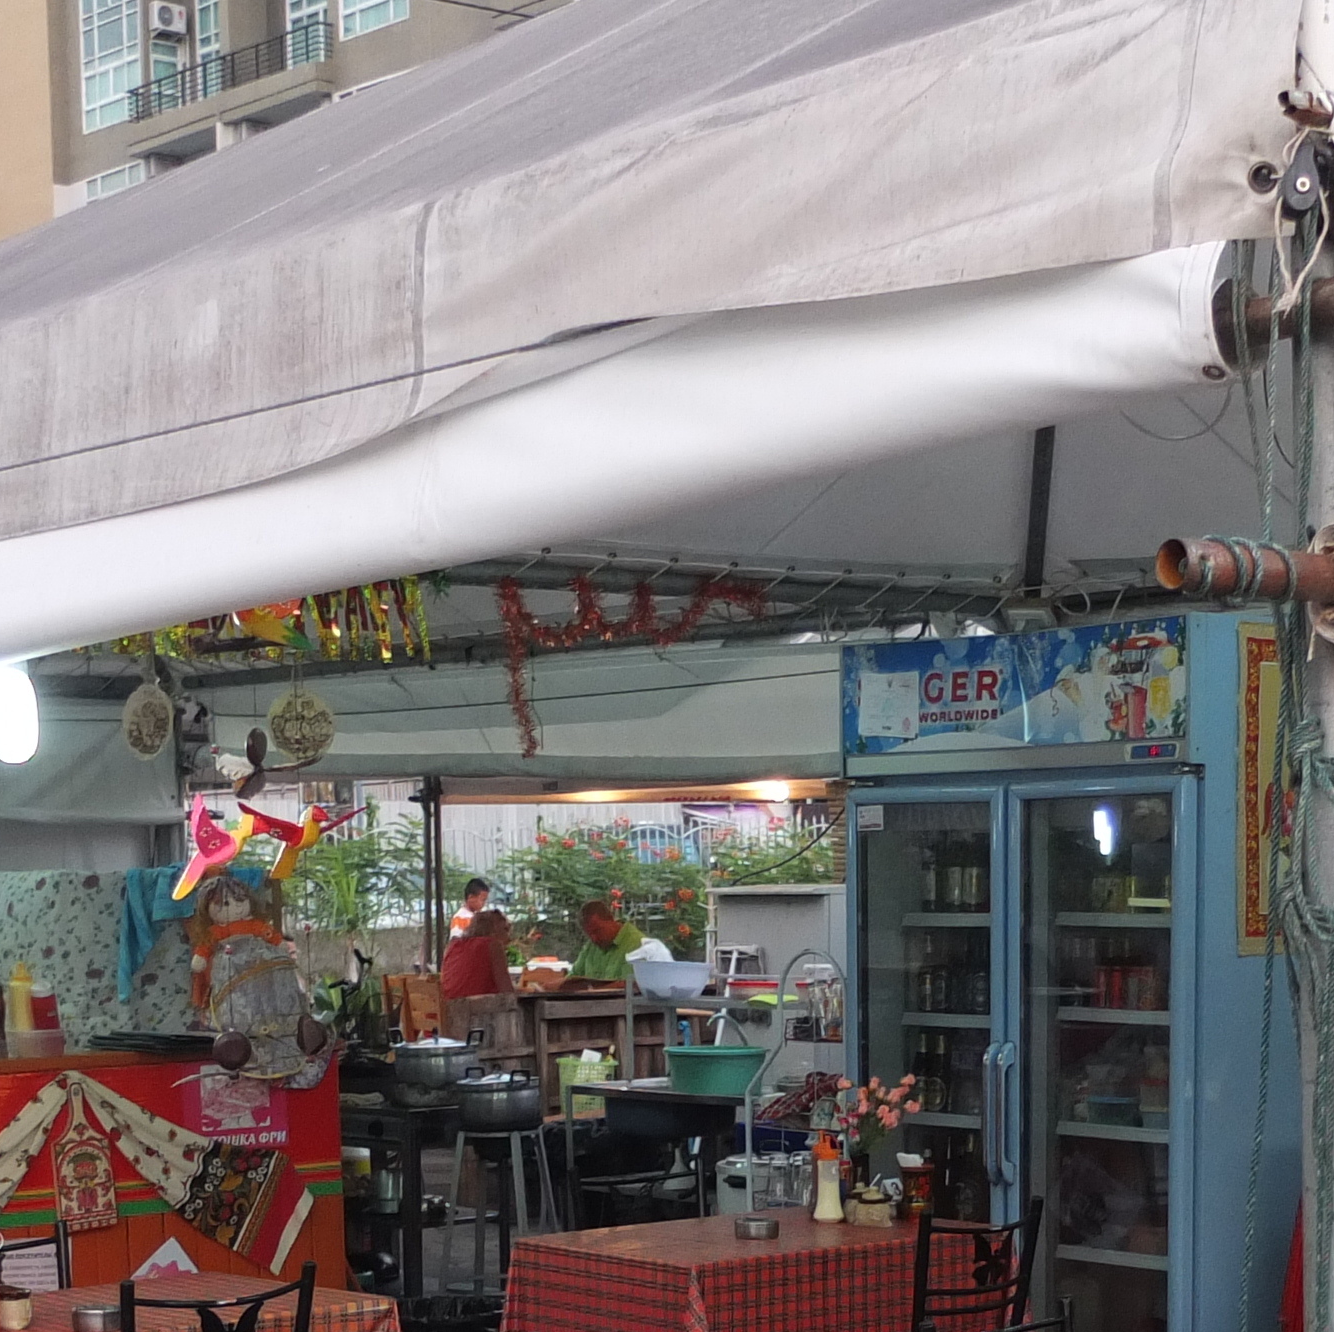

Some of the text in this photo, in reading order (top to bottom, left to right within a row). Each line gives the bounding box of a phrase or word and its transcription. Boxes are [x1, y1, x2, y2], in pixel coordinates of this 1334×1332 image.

[924, 668, 999, 704] GER
[919, 709, 998, 724] WORLDWIDE
[258, 1131, 286, 1143] ФРИ
